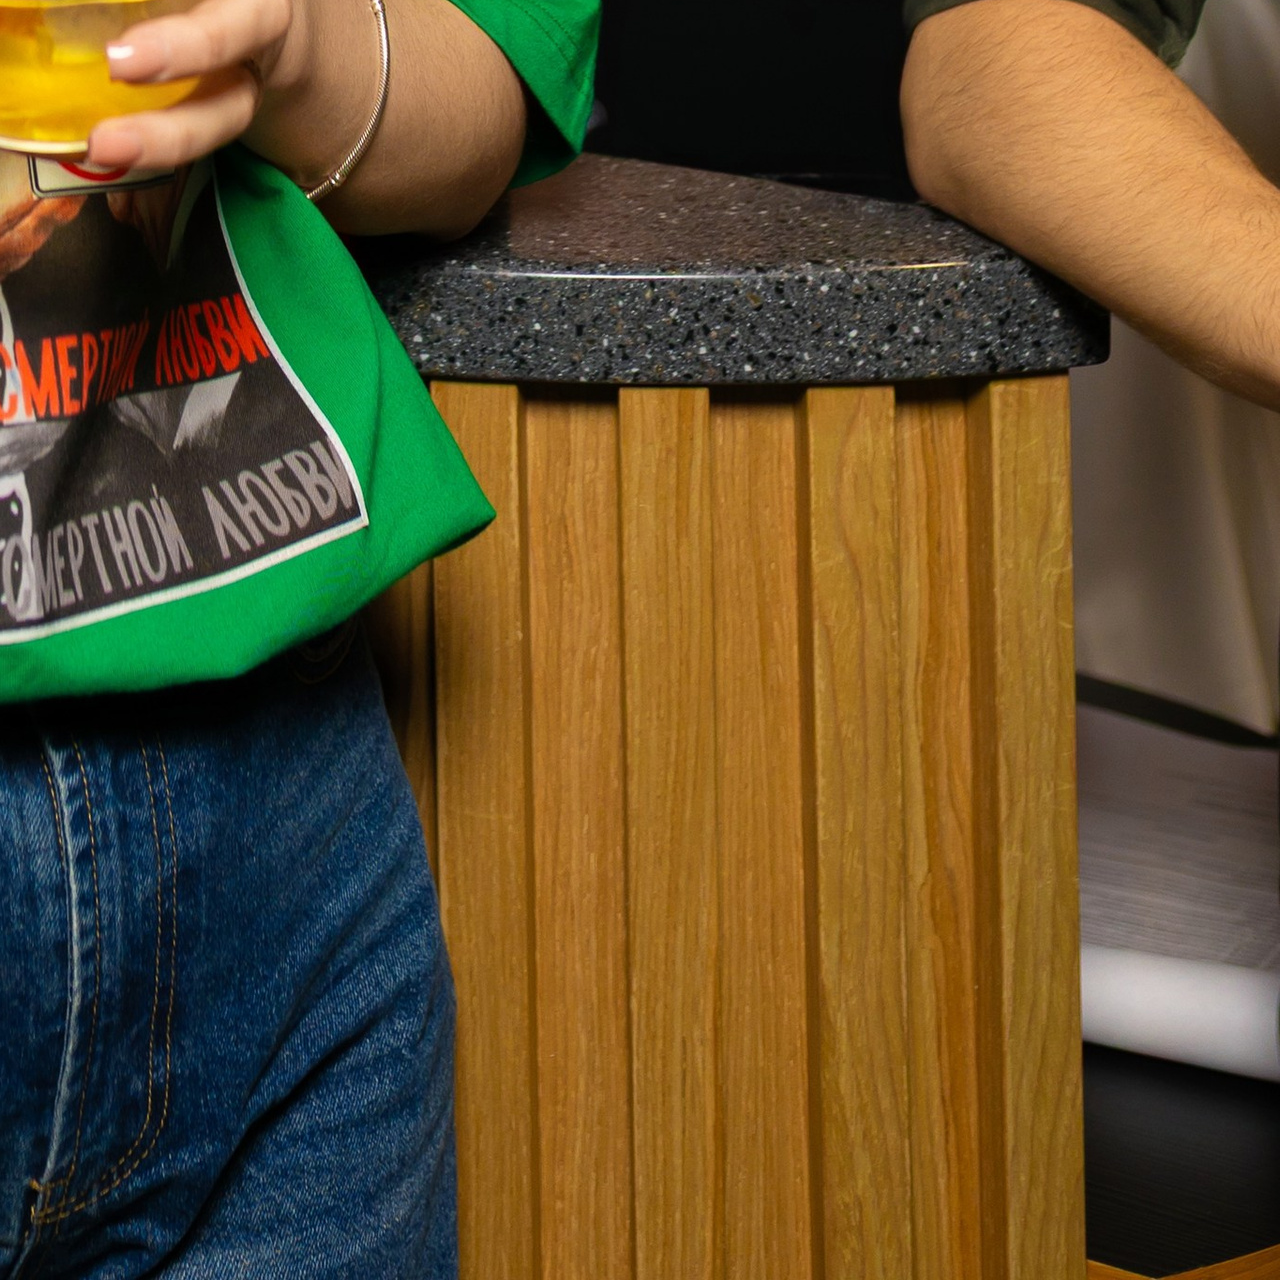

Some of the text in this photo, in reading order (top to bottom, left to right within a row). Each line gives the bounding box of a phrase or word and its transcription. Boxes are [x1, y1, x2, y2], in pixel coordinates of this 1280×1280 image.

[154, 292, 271, 386] ЛЮБВИ
[2, 484, 194, 621] СМЕРТНОЙ
[202, 435, 354, 559] ЛЮБВИ
